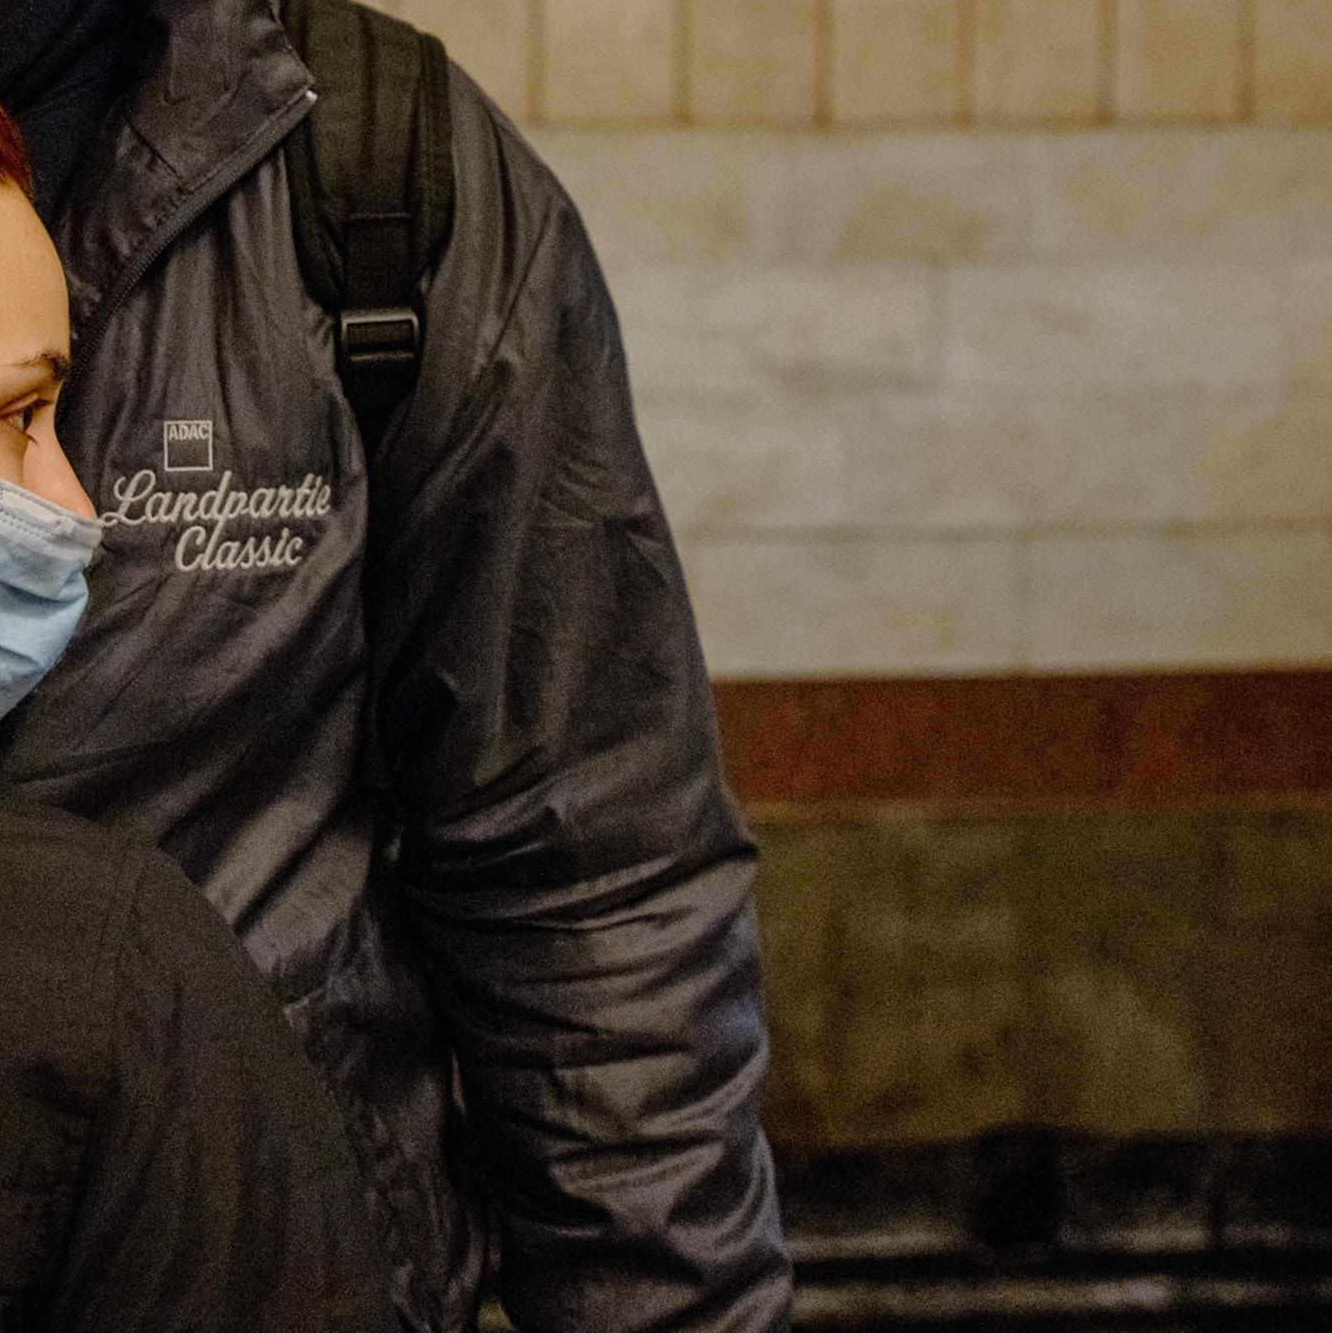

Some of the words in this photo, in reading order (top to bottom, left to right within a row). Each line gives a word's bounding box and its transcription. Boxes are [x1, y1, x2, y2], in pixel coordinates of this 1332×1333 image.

[168, 423, 209, 441] ADAC
[101, 469, 331, 527] Landpartie
[174, 524, 304, 572] Classic
